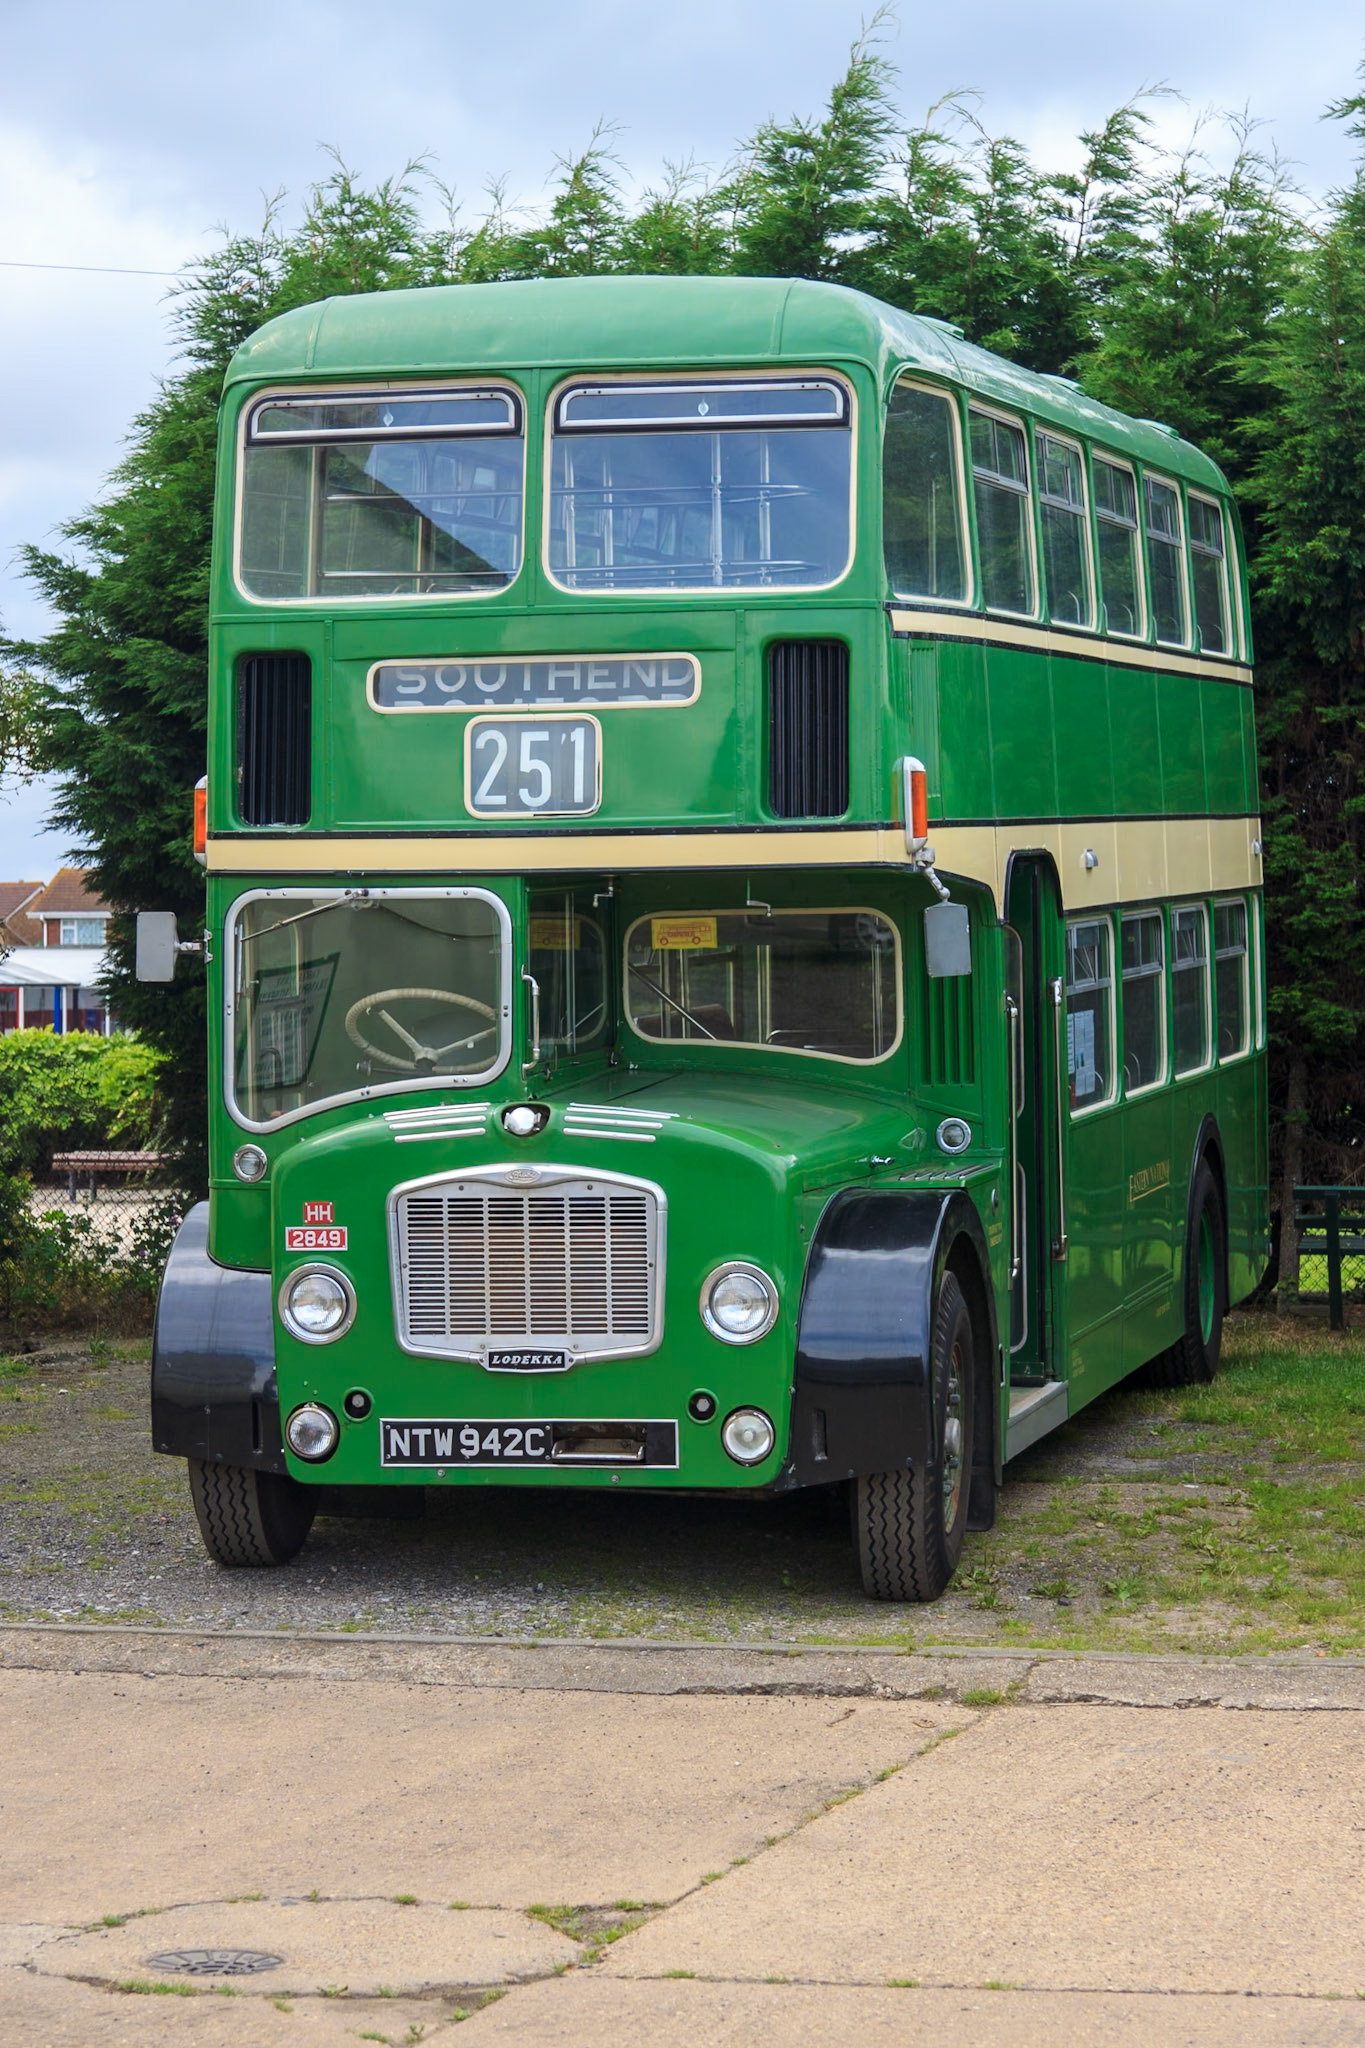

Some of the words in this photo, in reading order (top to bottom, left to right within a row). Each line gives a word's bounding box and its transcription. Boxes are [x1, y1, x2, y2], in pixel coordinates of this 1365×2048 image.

[395, 660, 693, 694] SOUTHEND
[474, 727, 586, 808] 251
[307, 1205, 331, 1221] HH
[292, 1230, 341, 1247] 2849
[491, 1355, 563, 1365] LODEKKA
[389, 1428, 453, 1457] NTW
[459, 1428, 545, 1456] 942C
